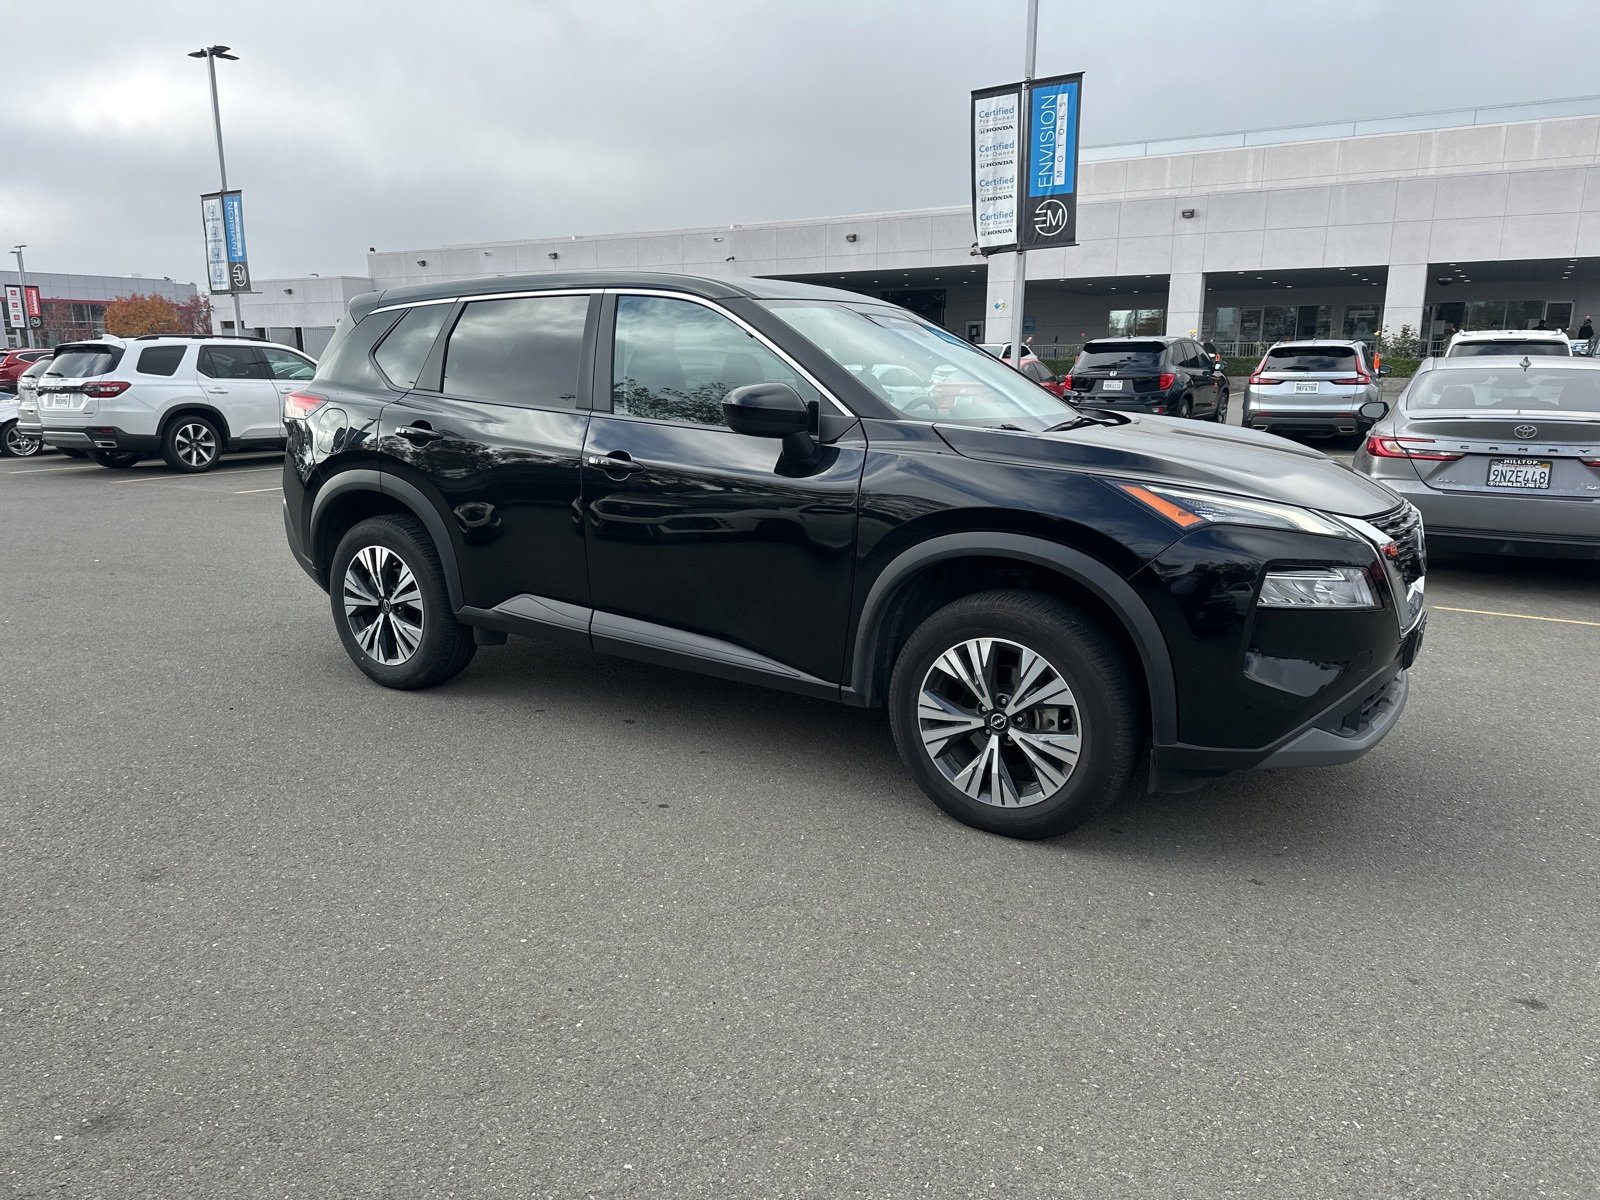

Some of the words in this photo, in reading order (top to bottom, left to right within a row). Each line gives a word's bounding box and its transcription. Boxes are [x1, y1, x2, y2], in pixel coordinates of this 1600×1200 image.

[979, 105, 1015, 118] Certified
[986, 125, 1014, 133] HONDA
[979, 140, 1015, 153] Certified
[1038, 94, 1056, 188] ENVISION
[1056, 101, 1066, 182] MOTORS
[979, 175, 1014, 187] Certified
[987, 194, 1013, 202] HONDA
[980, 209, 1013, 221] Certified
[1460, 445, 1591, 454] CAMRY
[1491, 469, 1547, 484] 9NZE448
